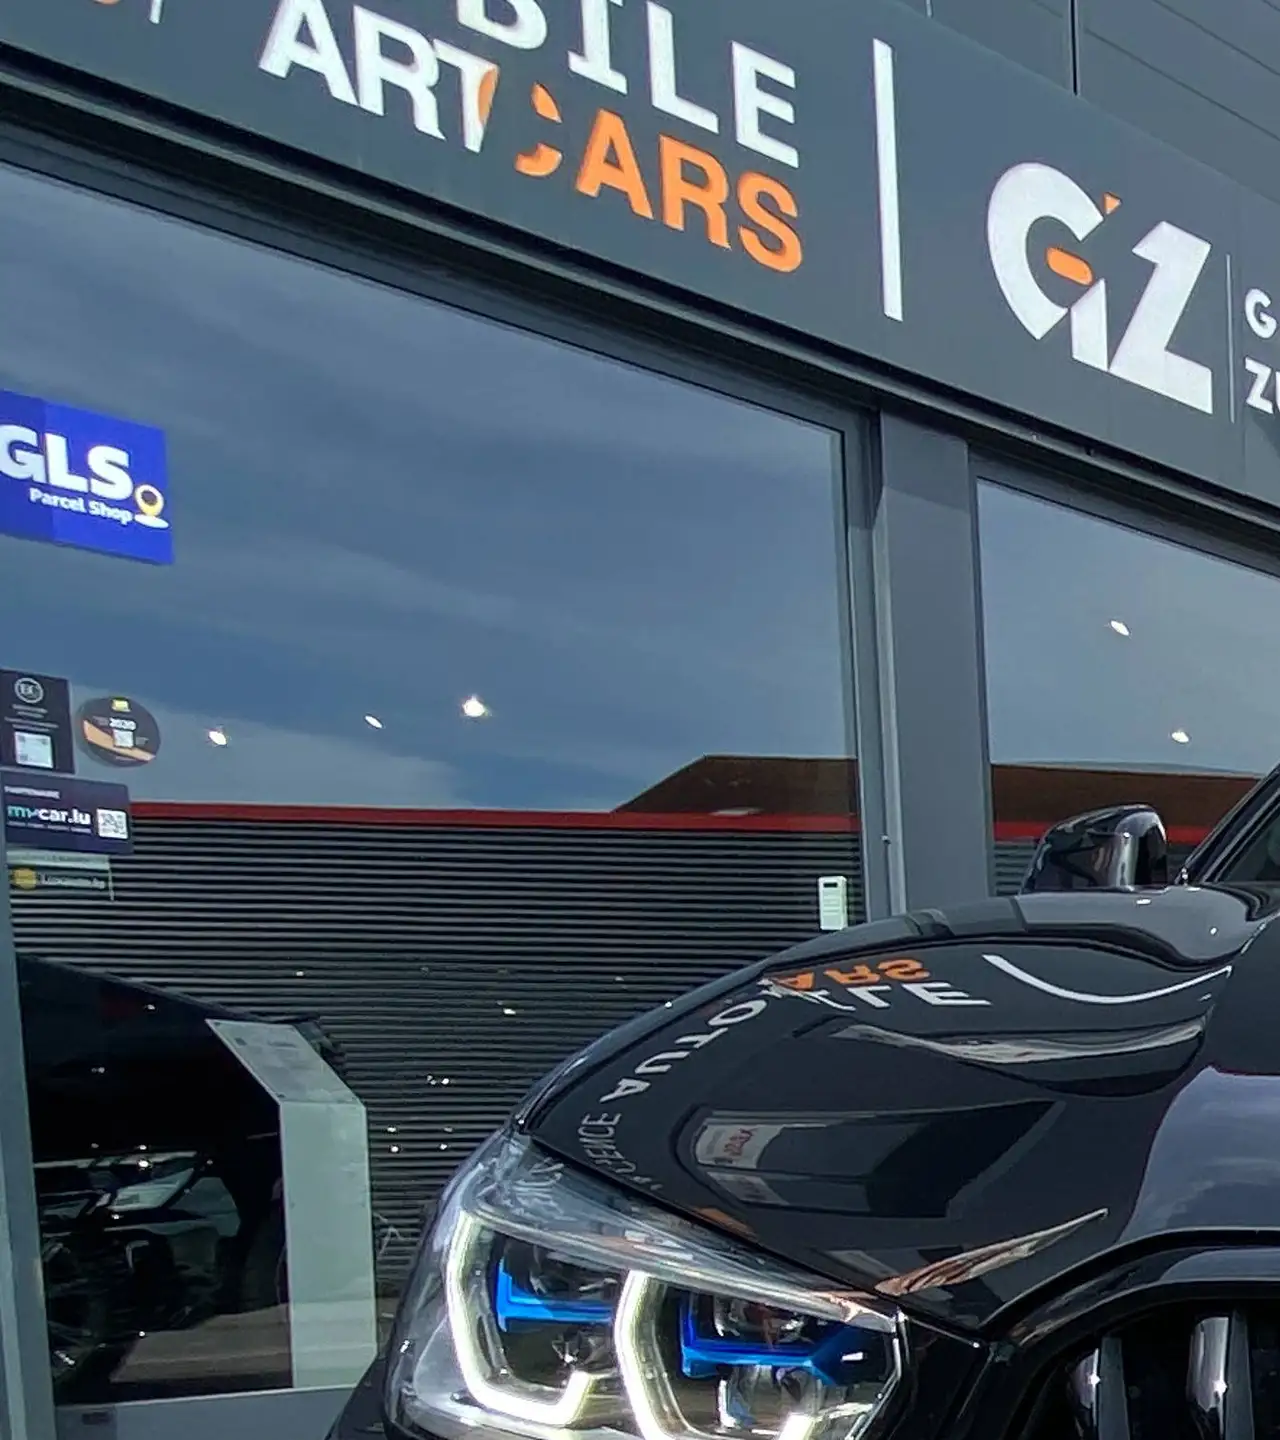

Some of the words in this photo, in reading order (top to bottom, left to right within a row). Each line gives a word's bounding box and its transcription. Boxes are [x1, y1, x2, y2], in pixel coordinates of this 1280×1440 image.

[0, 424, 134, 501] GLS
[29, 487, 87, 514] Parcel
[88, 499, 133, 527] Shop
